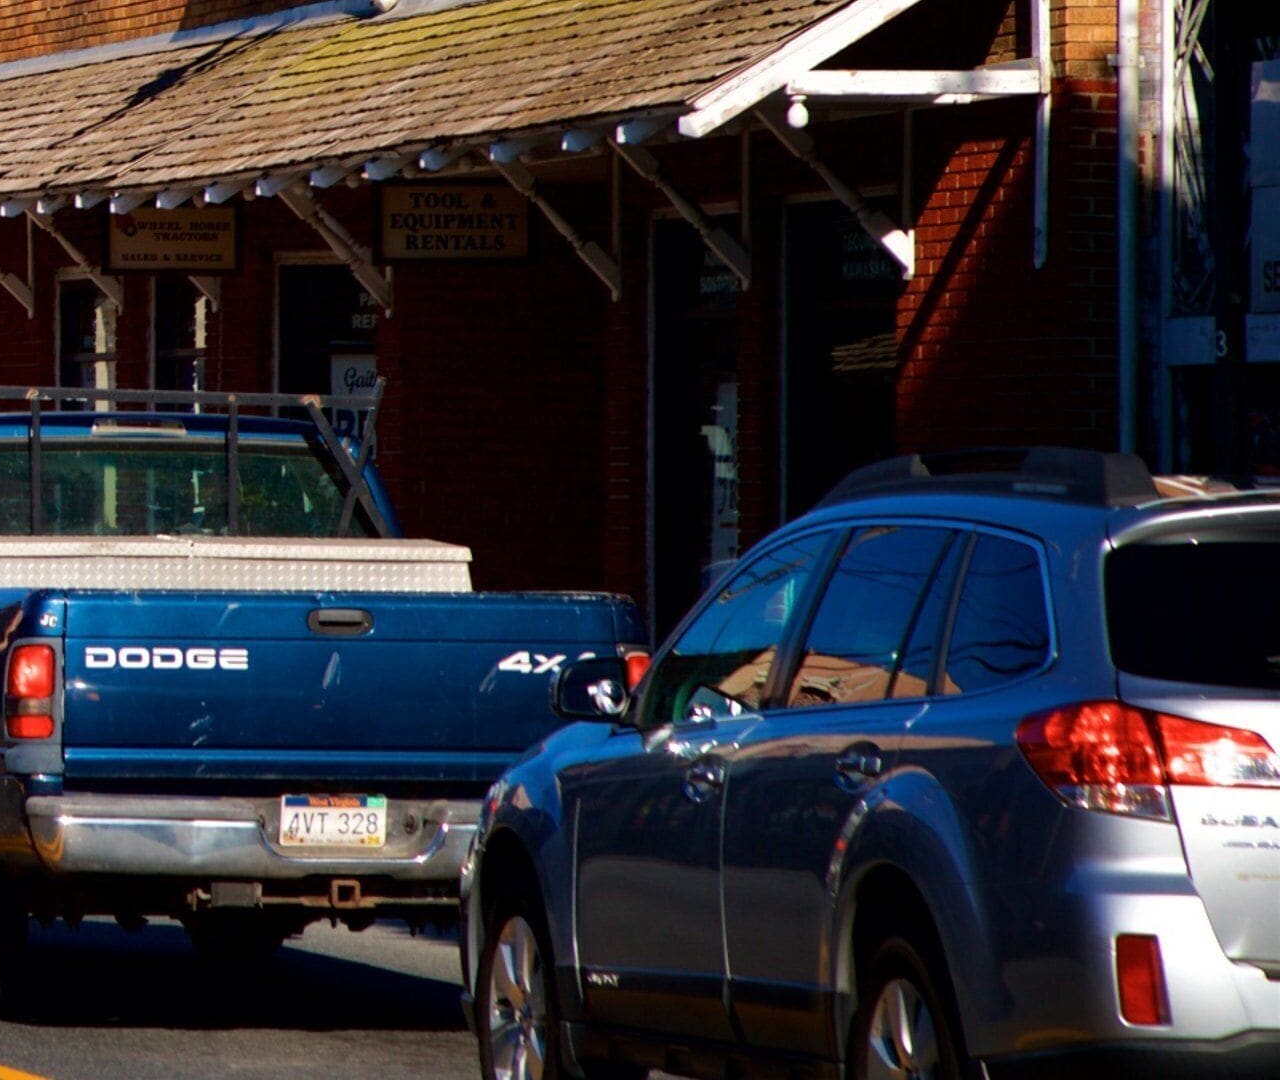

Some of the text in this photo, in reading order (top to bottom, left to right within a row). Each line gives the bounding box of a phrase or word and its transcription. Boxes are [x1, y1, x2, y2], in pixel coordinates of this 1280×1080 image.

[409, 192, 496, 209] TOOL &
[137, 221, 183, 231] WHEEL
[390, 213, 519, 233] EQUIPMENT
[152, 232, 220, 241] TRACTORS
[405, 235, 507, 251] RENTALS
[121, 253, 158, 262] SALES
[85, 647, 249, 670] DODGE
[338, 812, 378, 834] 328
